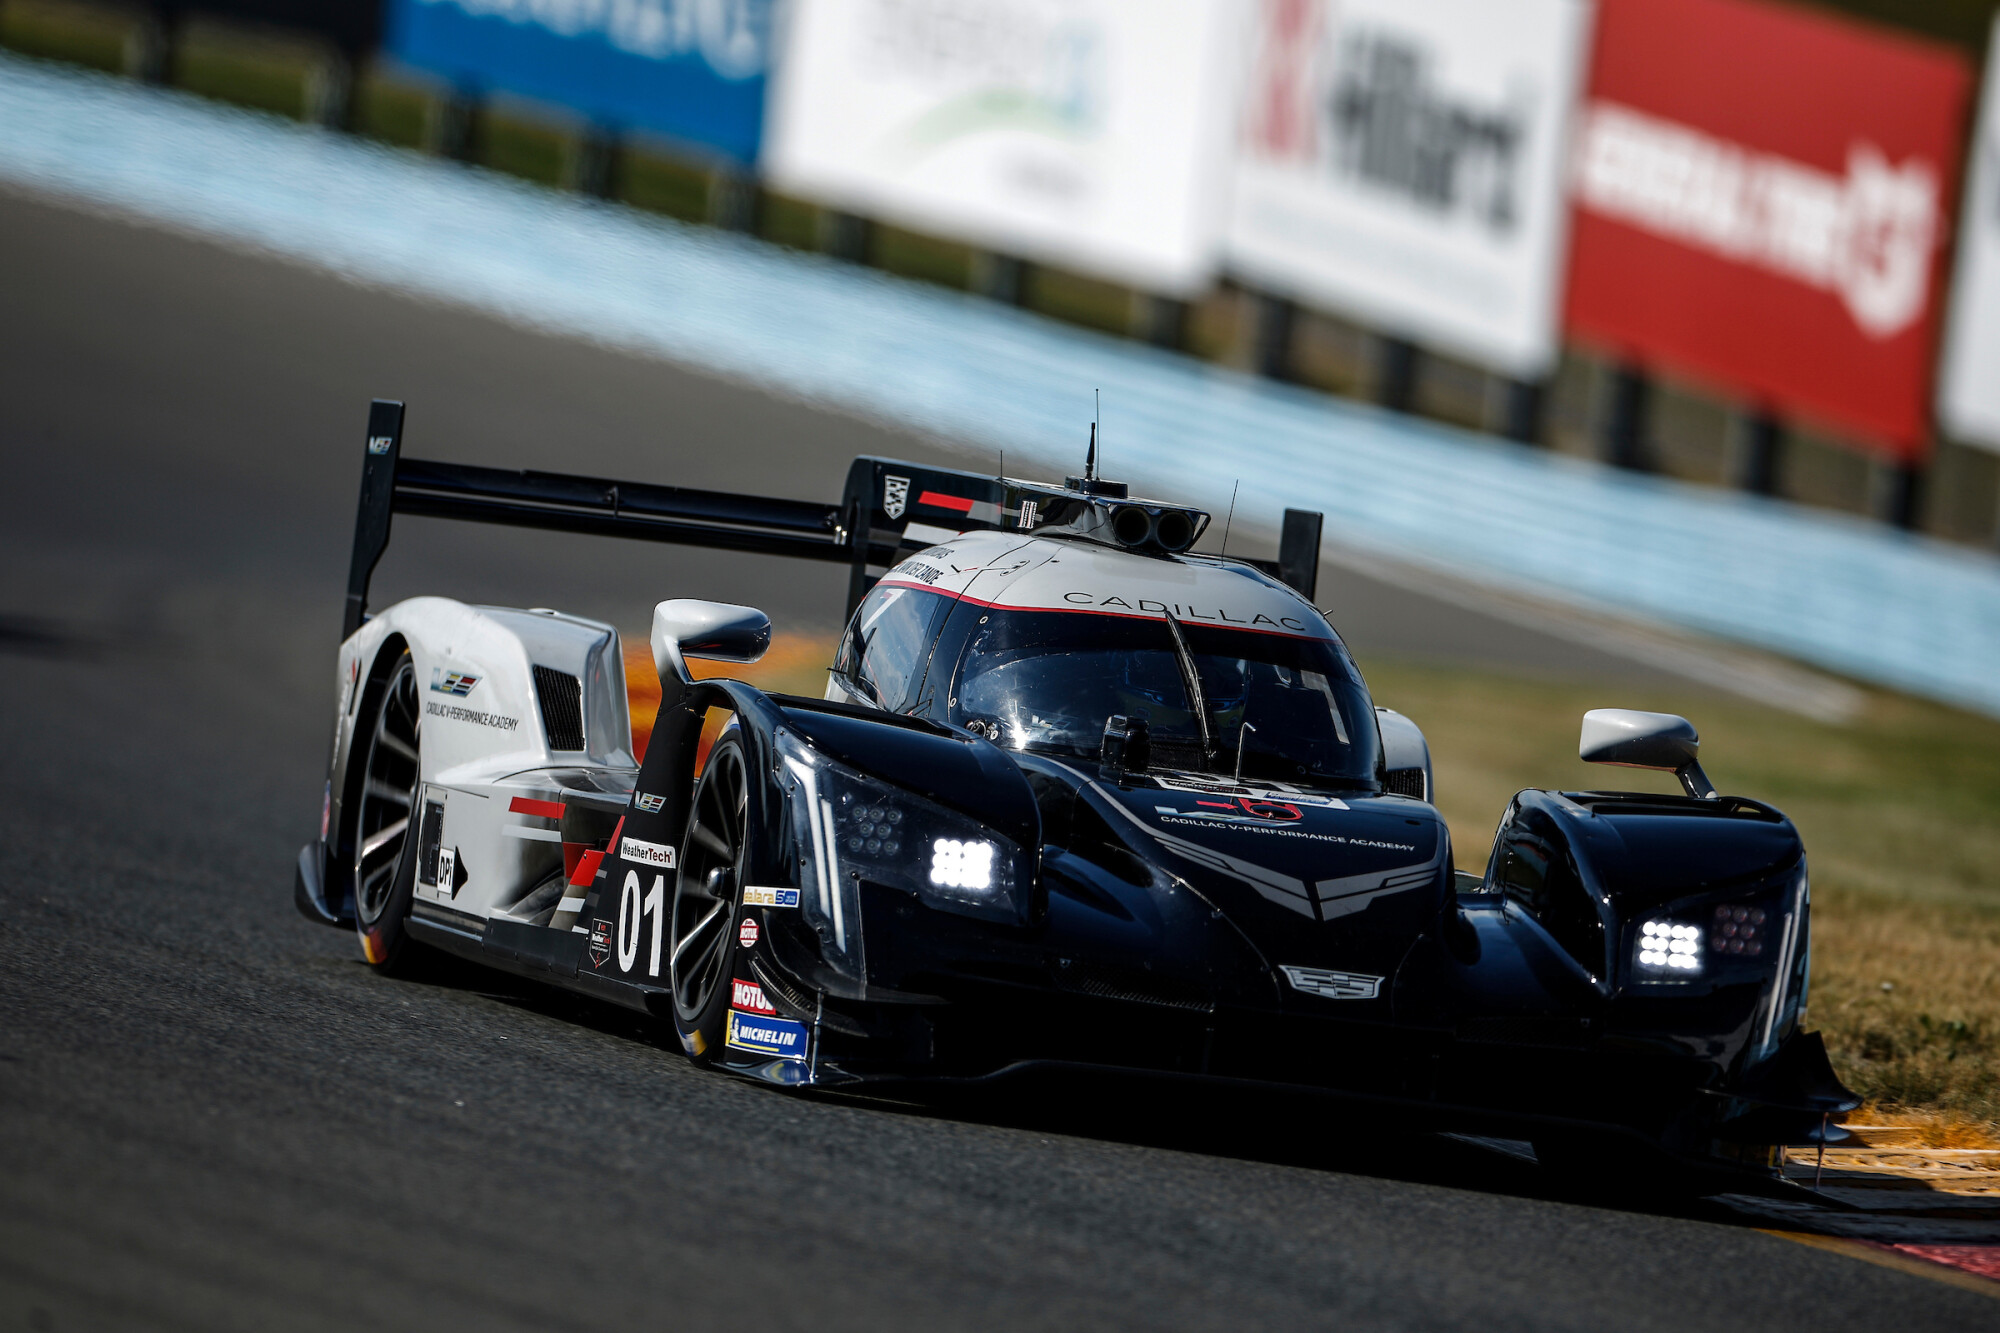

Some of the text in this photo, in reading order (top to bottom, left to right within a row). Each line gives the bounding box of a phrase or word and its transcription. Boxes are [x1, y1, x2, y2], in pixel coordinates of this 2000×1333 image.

[1063, 592, 1306, 631] CADILLAC
[426, 701, 519, 731] CADILLAC V-PERFORMANCE ACADEMY
[1160, 816, 1415, 851] CADILLAC V-PERFORMANCE ACADEMY
[439, 855, 453, 886] DPi
[618, 869, 664, 977] 01
[740, 1025, 797, 1046] MICHELIN
